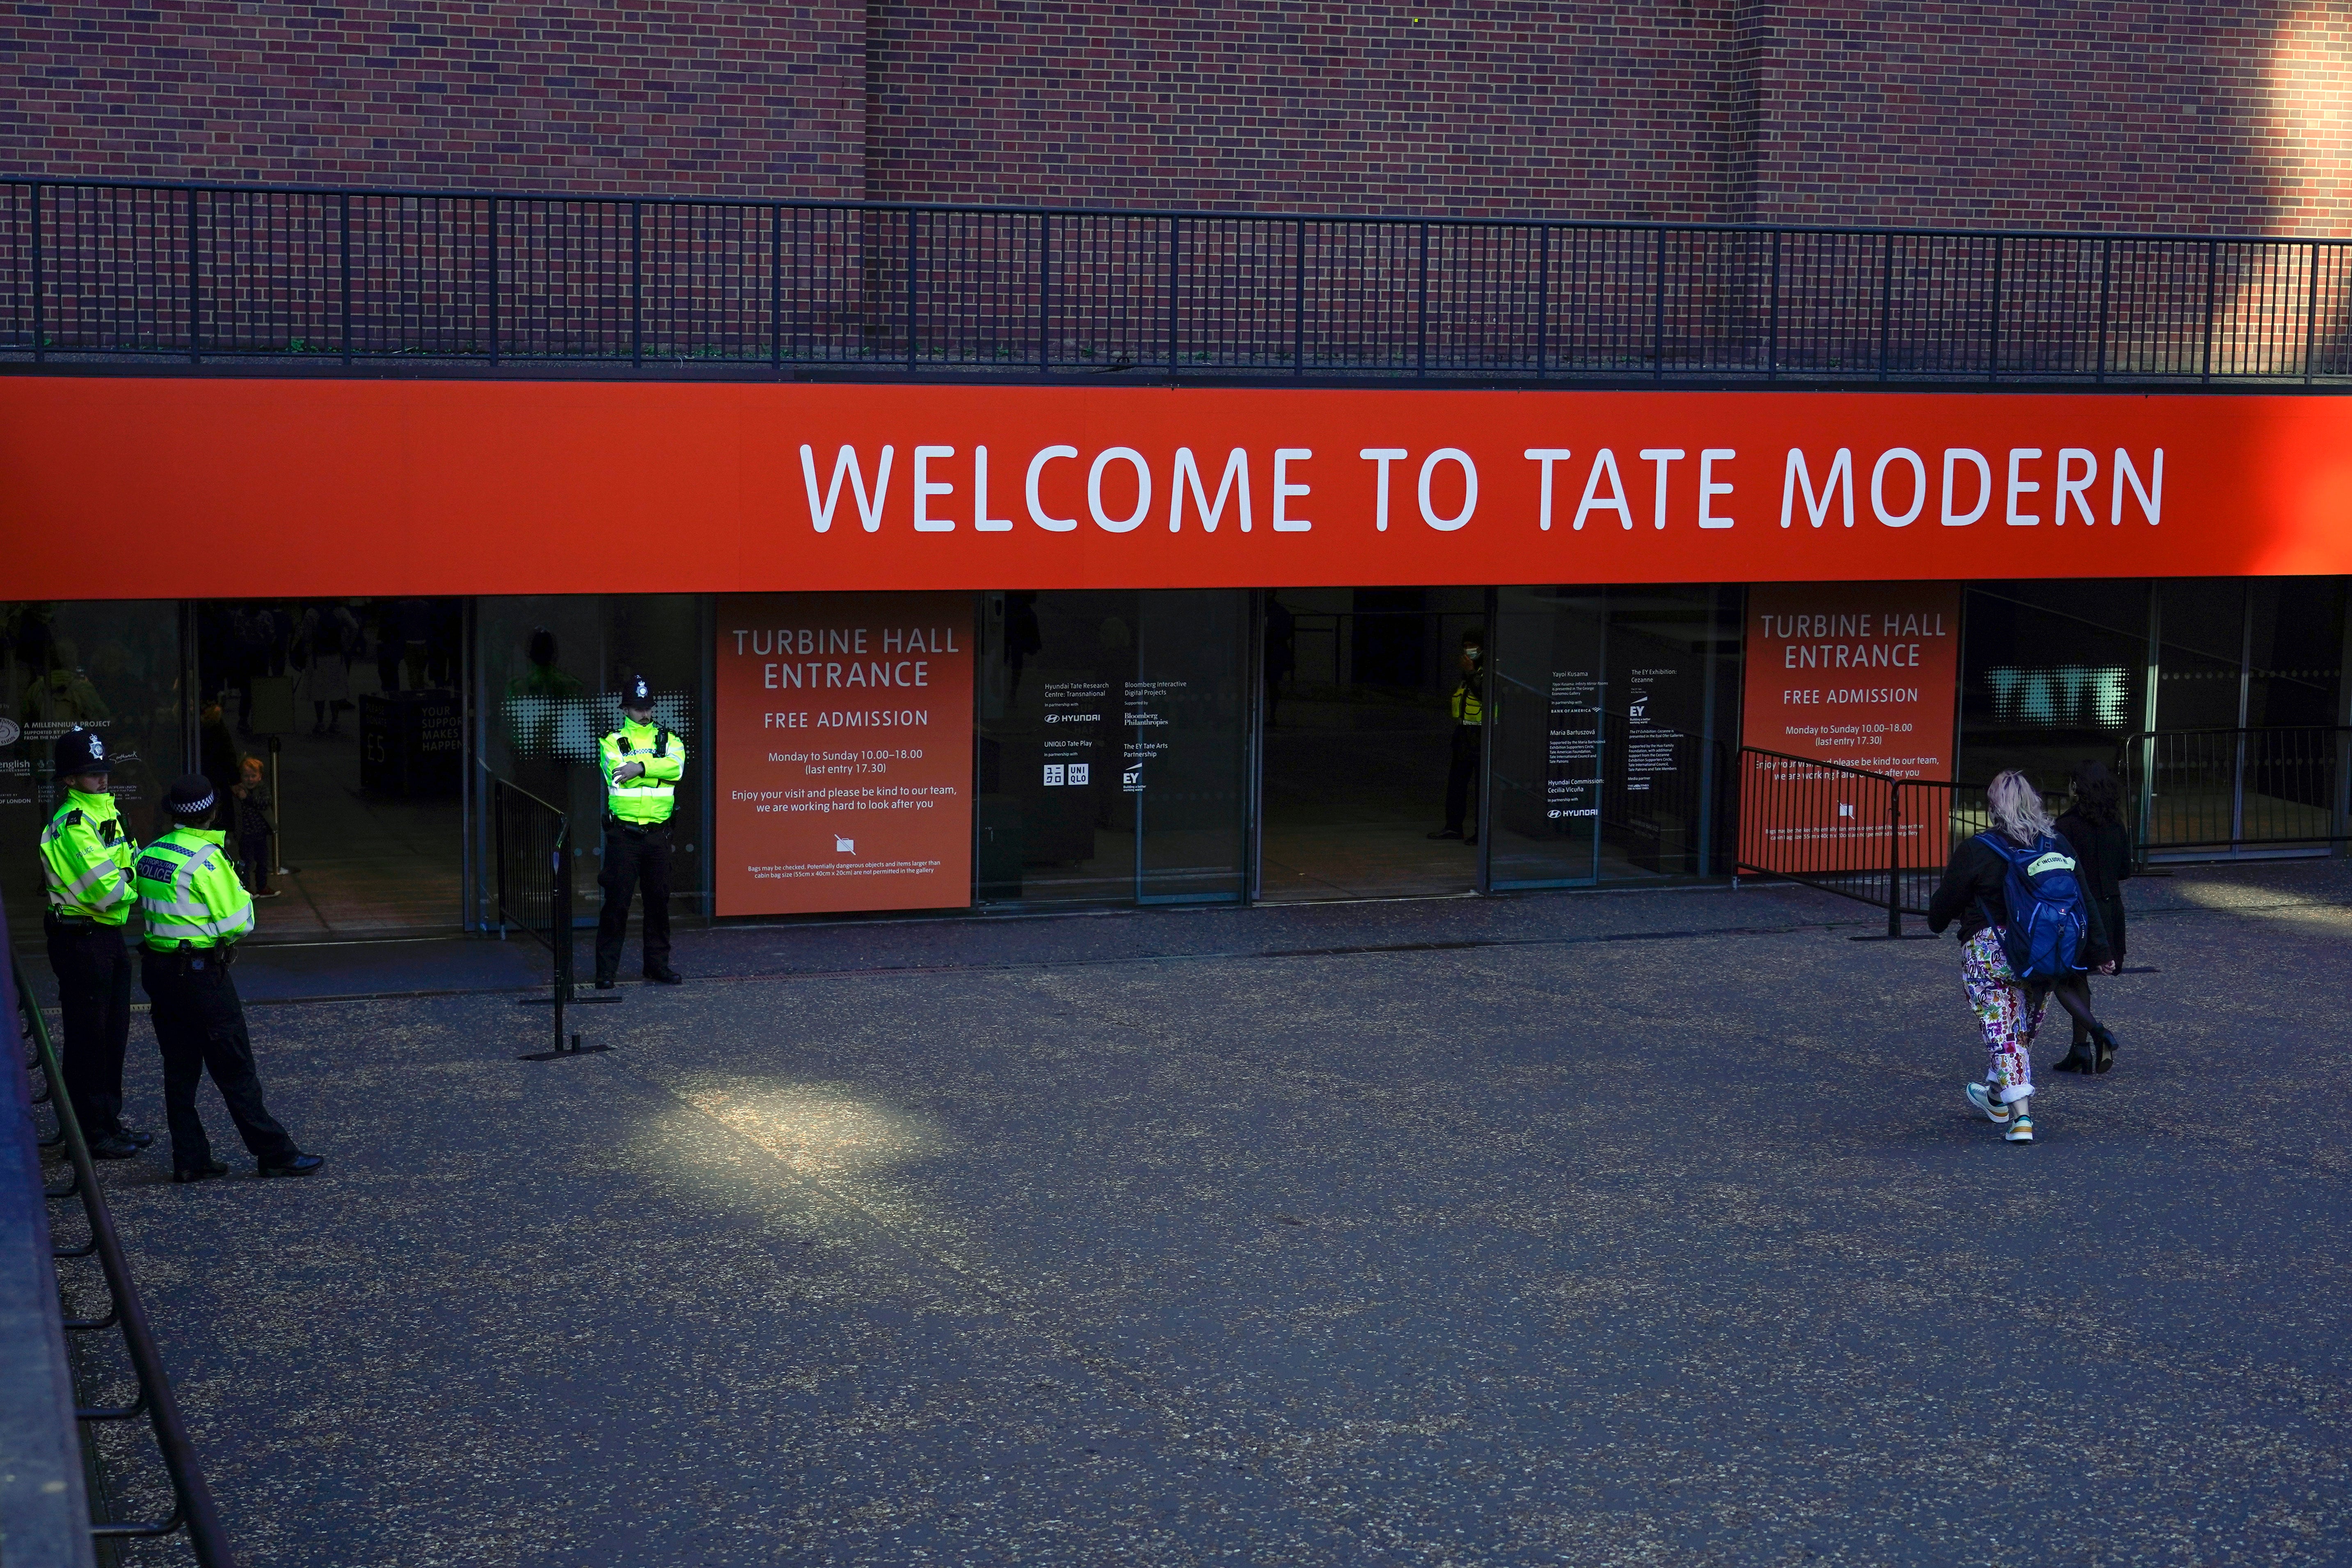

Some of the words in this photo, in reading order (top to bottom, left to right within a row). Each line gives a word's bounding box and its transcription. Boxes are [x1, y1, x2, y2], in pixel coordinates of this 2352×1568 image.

[799, 444, 1312, 533] WELCOME
[1359, 447, 1478, 532] TO
[1524, 448, 1736, 531] TATE
[1780, 447, 2164, 529] MODERN
[1761, 614, 1871, 638] TURBINE
[1884, 613, 1946, 636] HALL
[732, 629, 867, 655] TURBINE
[884, 627, 959, 654] HALL
[1785, 644, 1920, 668] ENTRANCE
[765, 661, 928, 689] ENTRANCE
[1125, 689, 1143, 697] Digital
[1784, 690, 1819, 704] FREE
[1826, 688, 1917, 703] ADMISSION
[421, 705, 451, 717] YOUR
[1124, 712, 1158, 721] Bloomberg
[1630, 706, 1645, 716] EY
[765, 712, 808, 728] FREE
[817, 710, 927, 727] ADMISSION
[1124, 719, 1168, 727] Philanthropies
[421, 728, 459, 740] MAKES
[1786, 725, 1819, 735] Monday
[1821, 725, 1828, 734] to
[1830, 724, 1860, 734] Sunday
[1815, 737, 1832, 747] (last
[1833, 738, 1855, 746] entry
[1857, 736, 1882, 746] 17.30)
[769, 751, 808, 762] Monday
[810, 752, 820, 761] to
[822, 751, 858, 762] Sunday
[1861, 757, 1872, 766] be
[1873, 757, 1891, 765] kind
[1917, 756, 1939, 765] team,
[805, 765, 826, 776] (last
[827, 766, 853, 775] entry
[856, 763, 886, 774] 17.30)
[1885, 769, 1904, 777] after
[1071, 775, 1086, 783] QLO
[1123, 772, 1139, 784] EY
[732, 790, 758, 801] Enjoy
[760, 791, 782, 801] your
[785, 789, 805, 798] visit
[807, 788, 826, 798] and
[828, 787, 860, 799] please
[862, 787, 874, 796] be
[876, 786, 897, 796] kind
[900, 787, 909, 795] to
[930, 786, 957, 795] team,
[790, 801, 830, 813] working
[832, 800, 854, 810] hard
[857, 801, 866, 810] to
[869, 799, 889, 809] look
[891, 799, 914, 809] after
[916, 801, 933, 810] you
[76, 845, 94, 859] POLICE
[137, 863, 173, 882] POLICE
